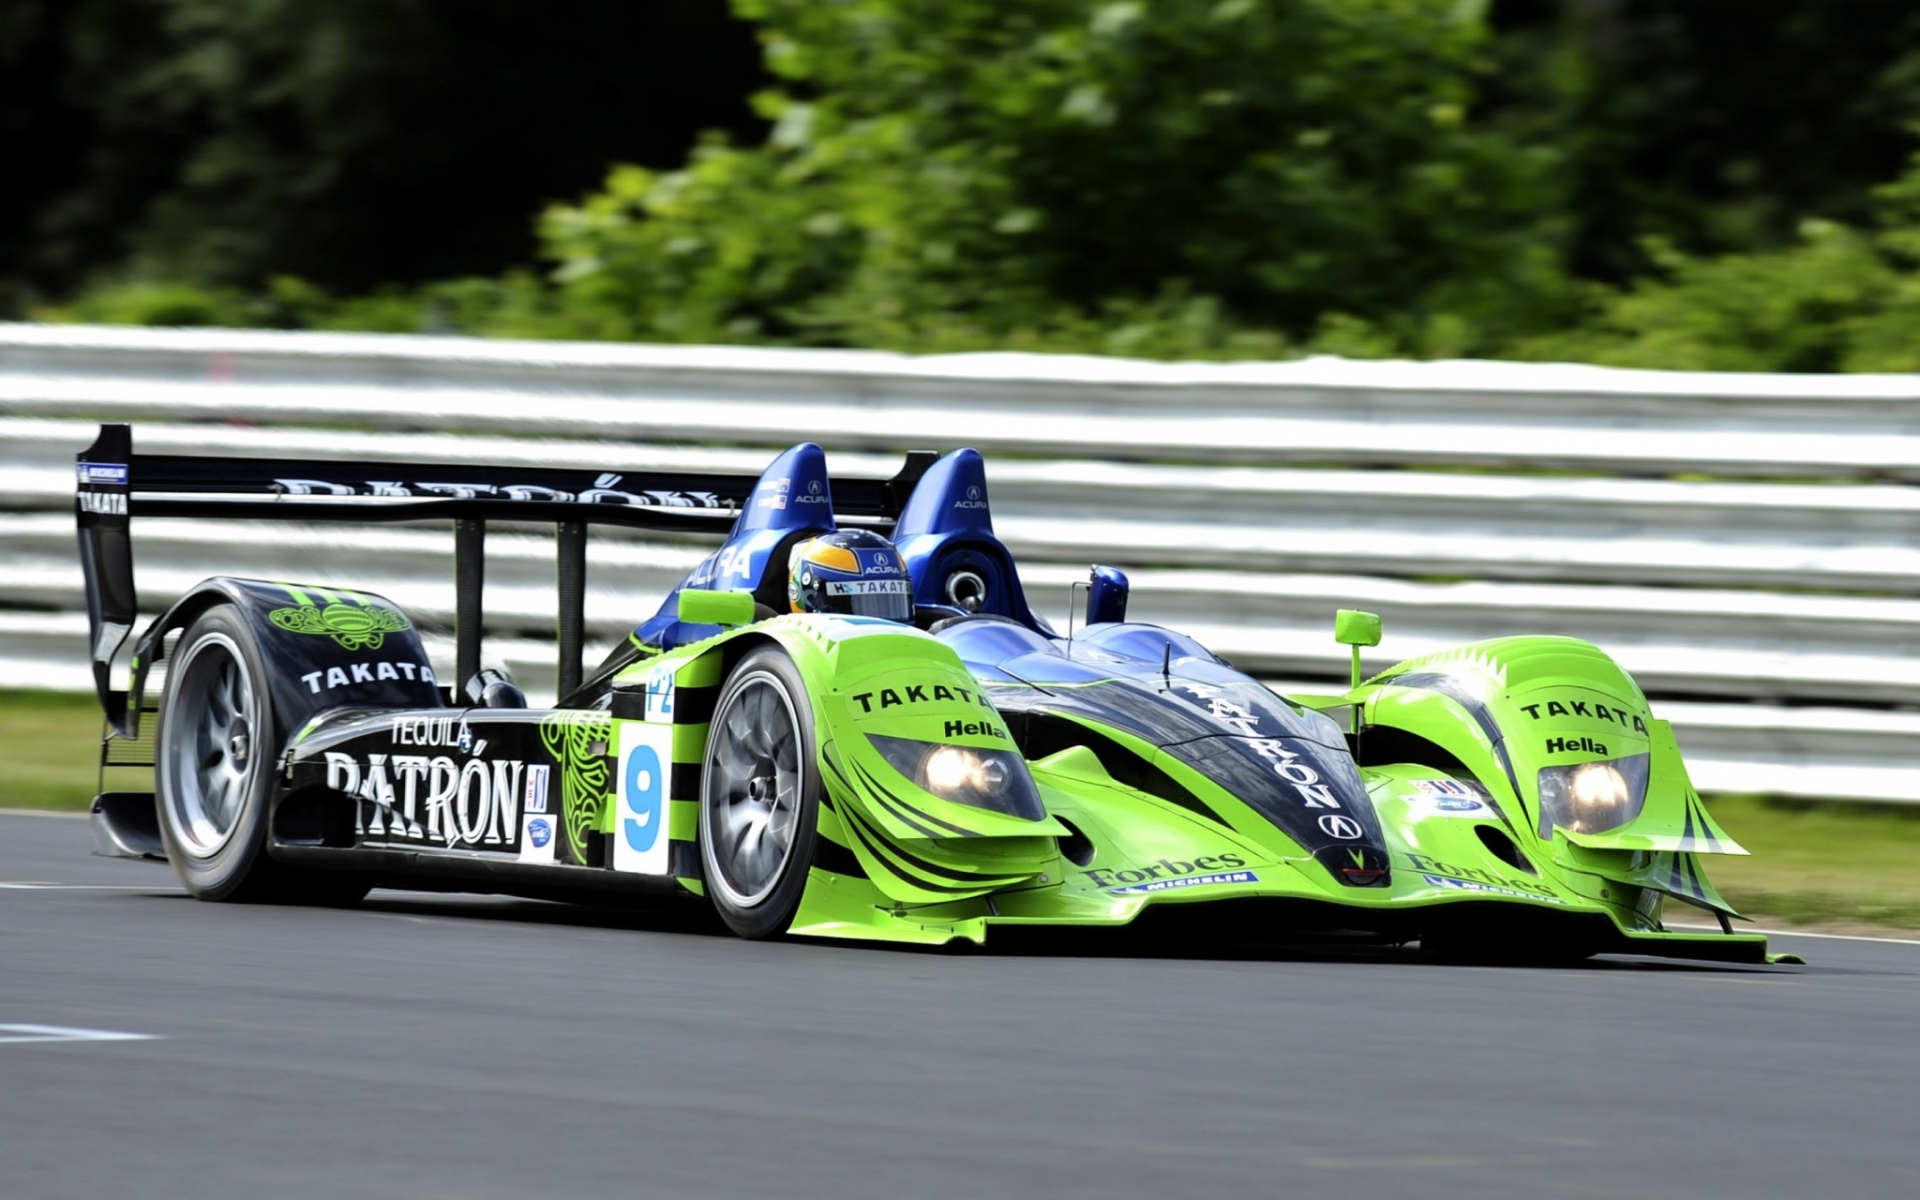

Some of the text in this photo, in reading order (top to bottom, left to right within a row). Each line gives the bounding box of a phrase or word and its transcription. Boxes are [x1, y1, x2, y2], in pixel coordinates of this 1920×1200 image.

[865, 566, 900, 574] ACURA
[301, 662, 437, 694] TAKATA
[648, 667, 673, 713] P2
[852, 685, 995, 713] TAKATA
[392, 716, 471, 747] TEQUILA
[944, 720, 1007, 739] Hella
[1520, 701, 1649, 737] TAKATA
[1546, 737, 1608, 756] Hella
[324, 740, 524, 849] PATRÓN
[624, 745, 662, 852] 9
[1079, 853, 1246, 888] Forbes
[1147, 873, 1248, 891] MICHELIN
[1402, 852, 1558, 897] Forbes
